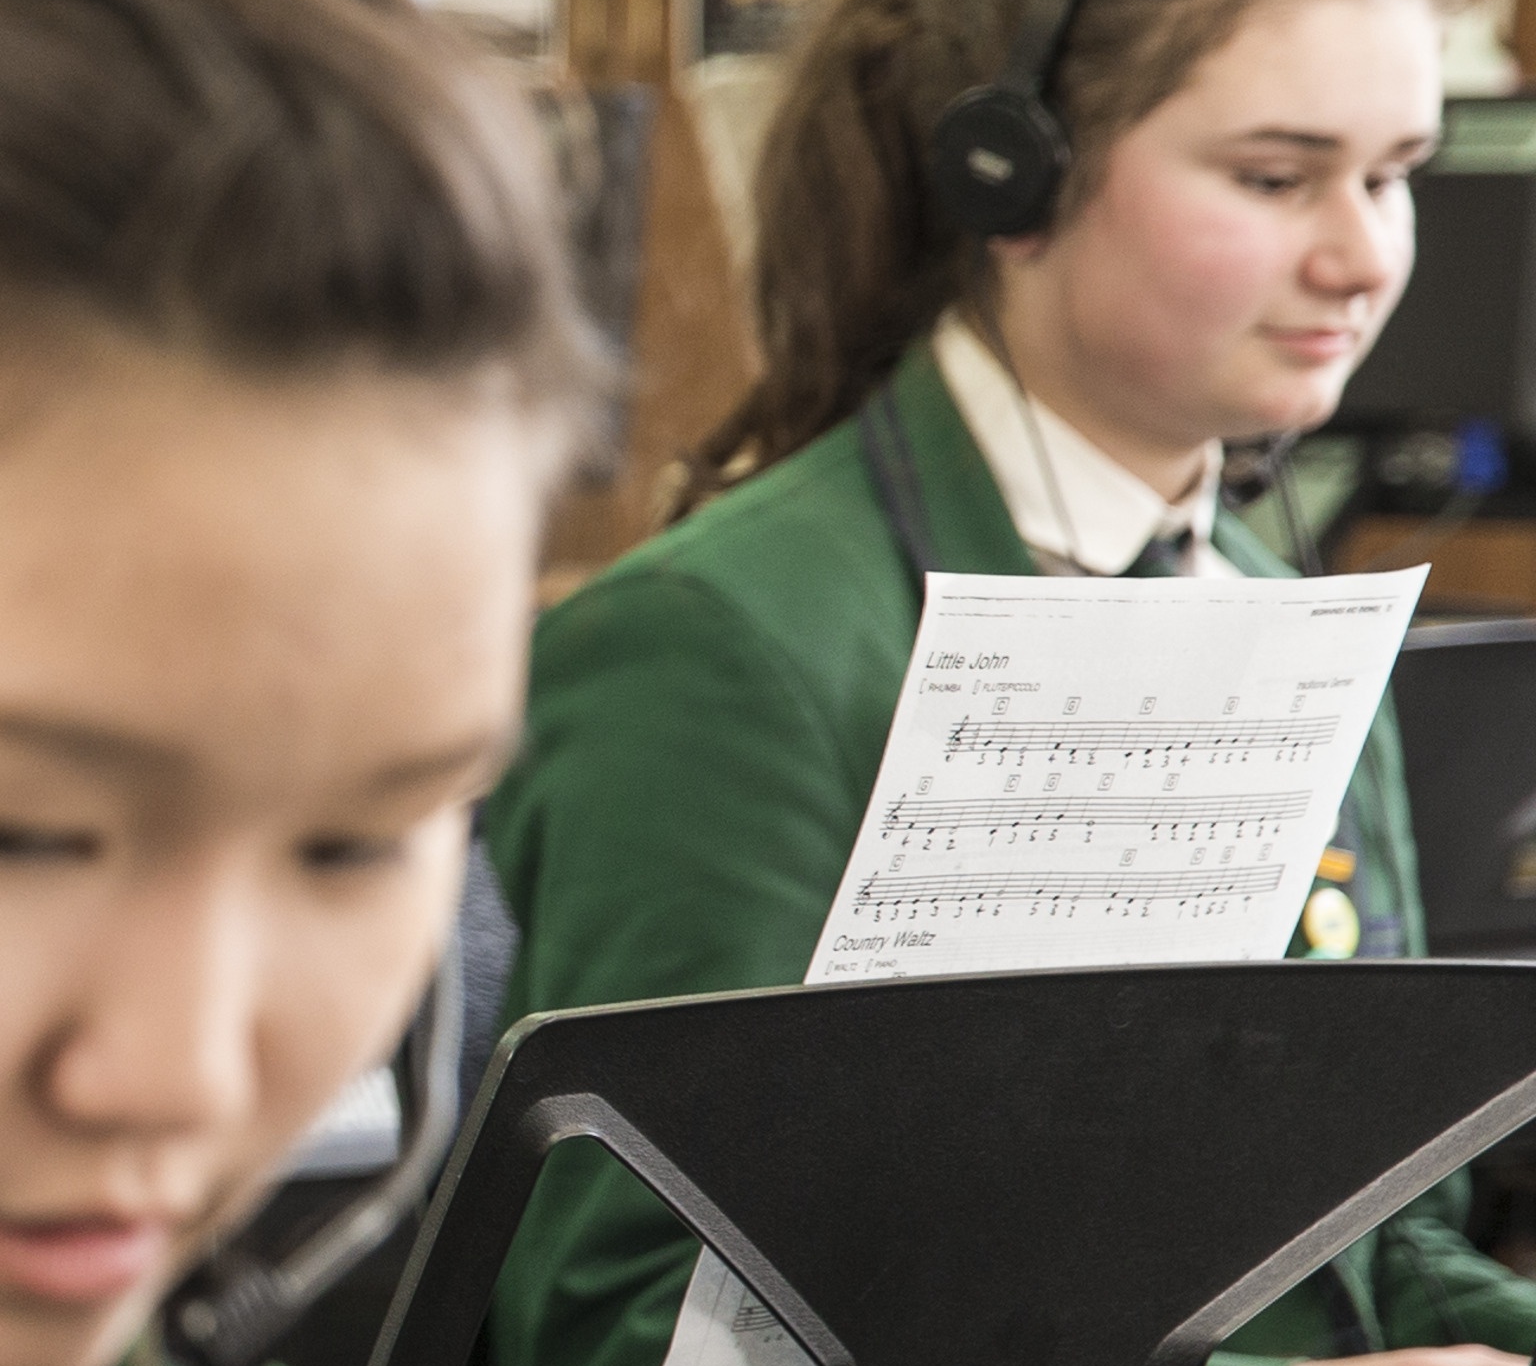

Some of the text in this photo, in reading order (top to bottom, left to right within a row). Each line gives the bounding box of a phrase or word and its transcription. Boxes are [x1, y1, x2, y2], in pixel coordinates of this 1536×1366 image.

[925, 652, 1010, 670] Little John
[832, 930, 936, 953] Country Waltz
